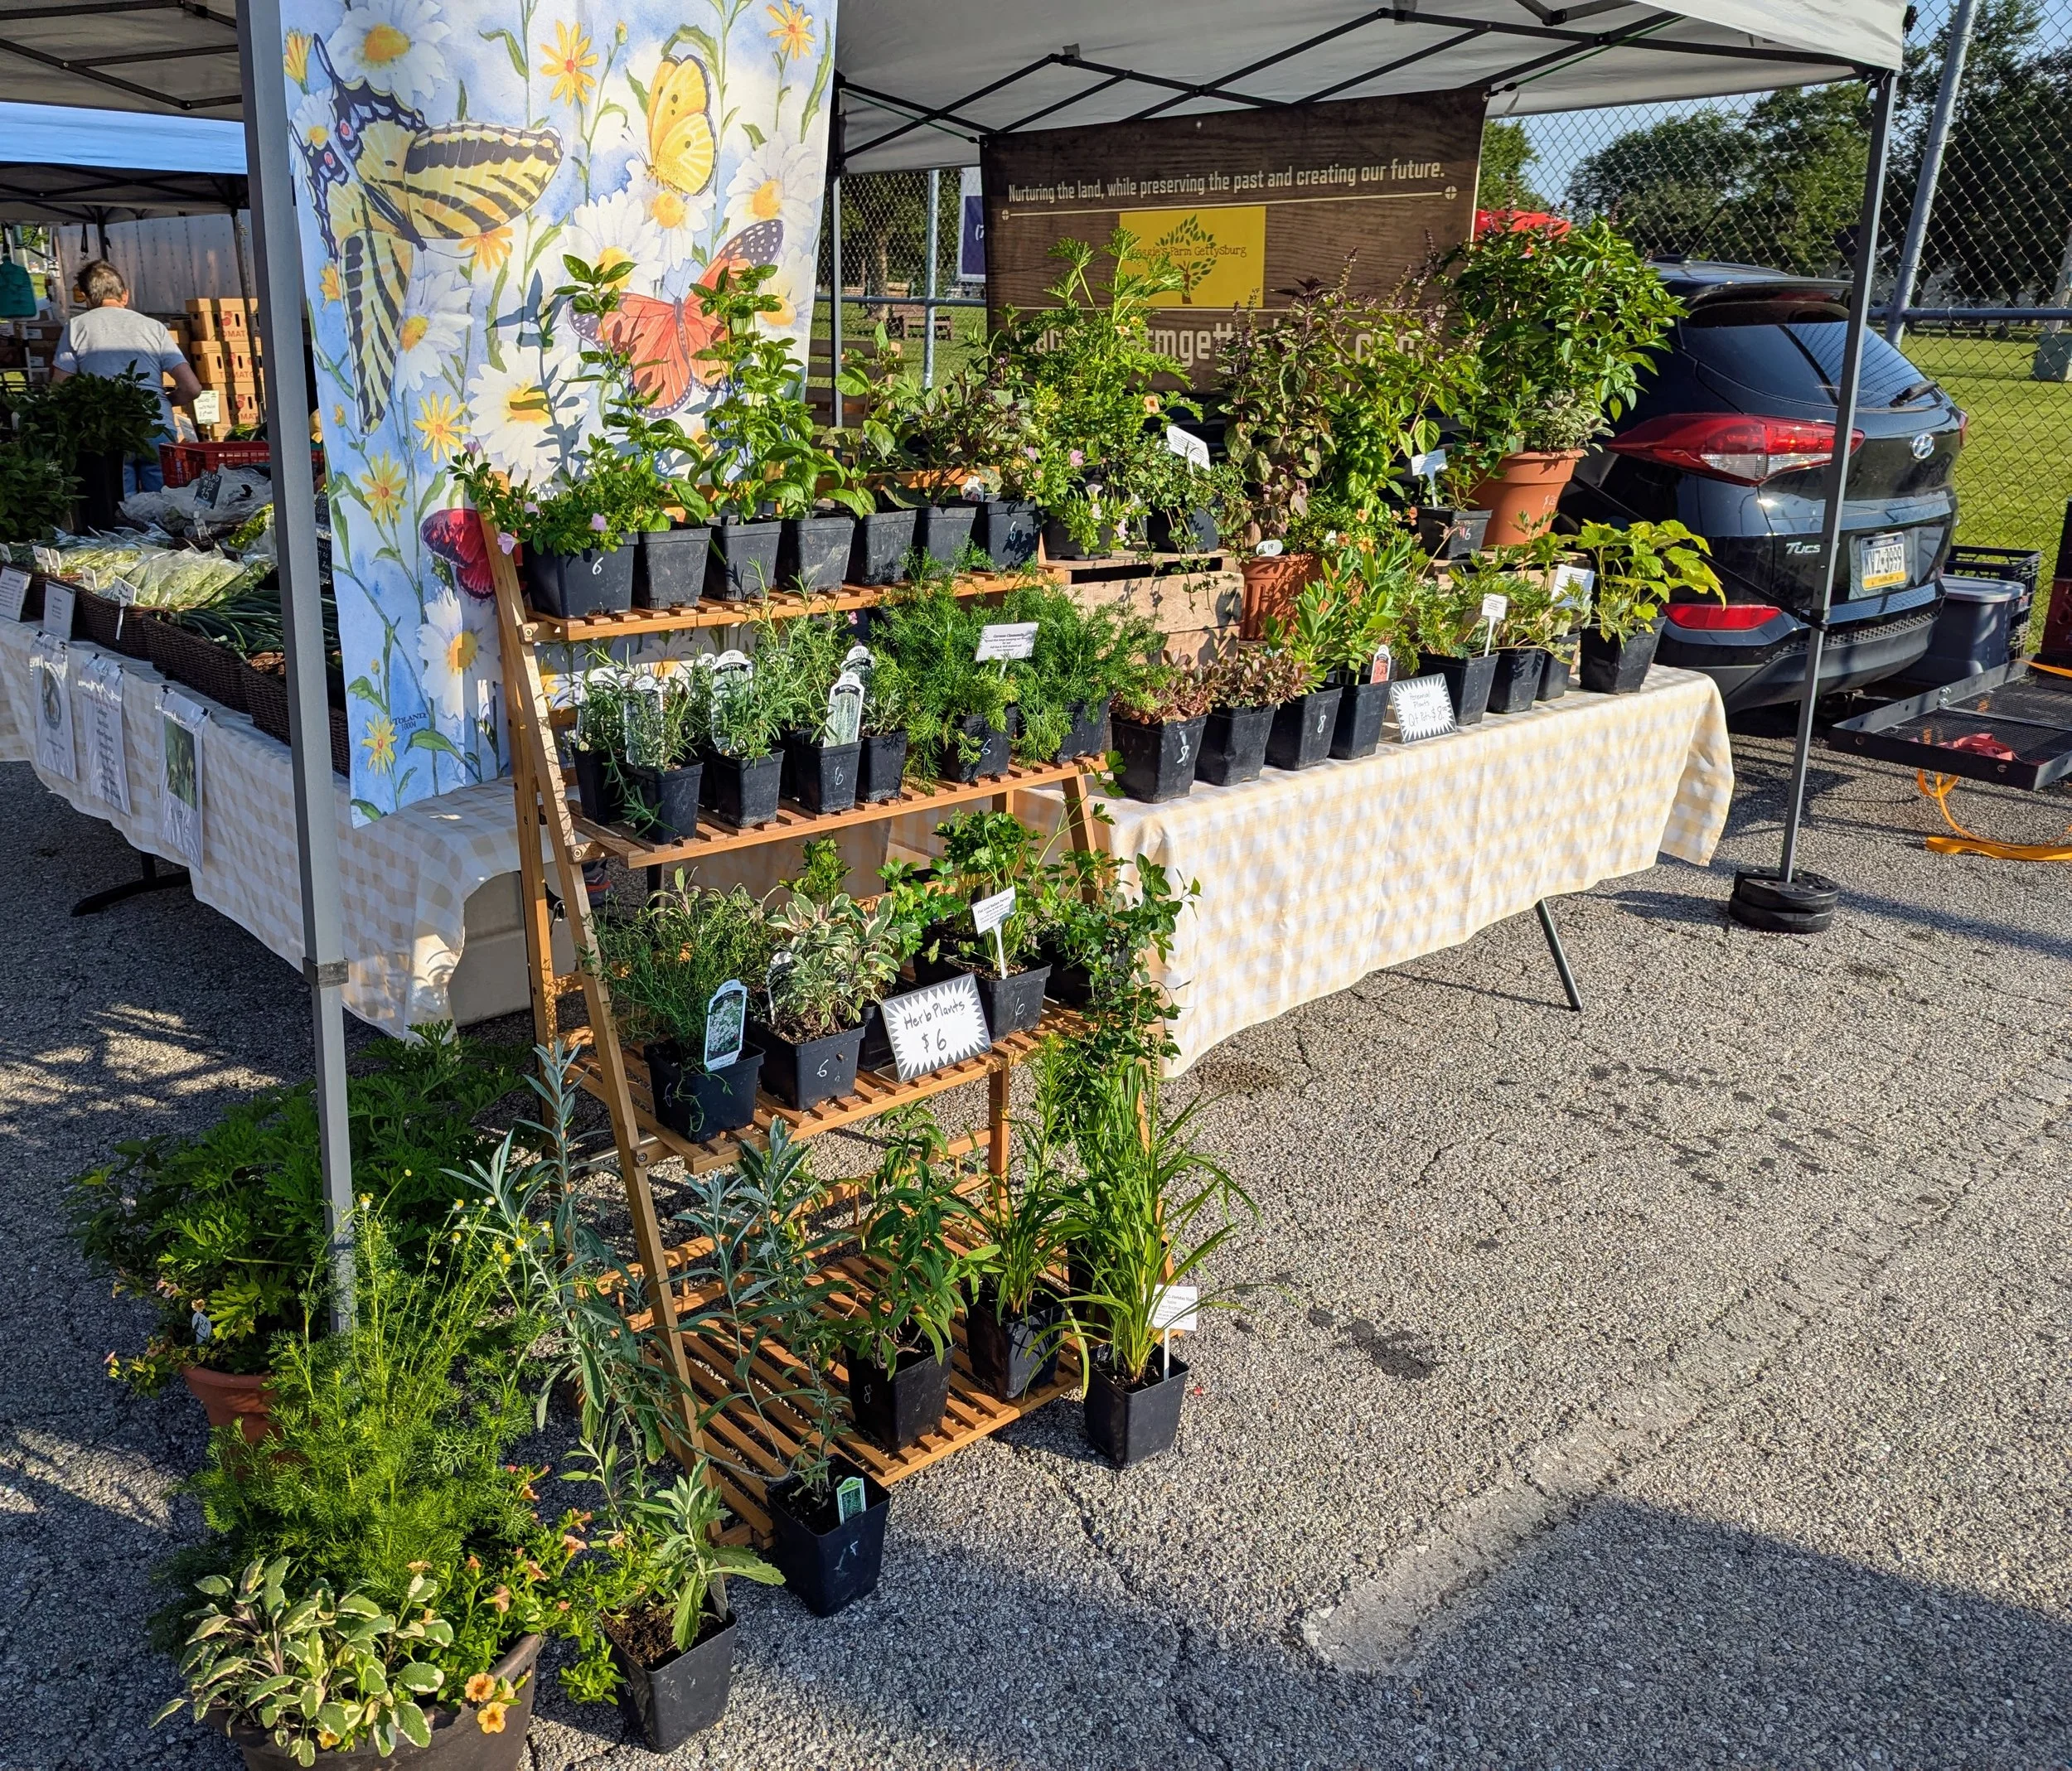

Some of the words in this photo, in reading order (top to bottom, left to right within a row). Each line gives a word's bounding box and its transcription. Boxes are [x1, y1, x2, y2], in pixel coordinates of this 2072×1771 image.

[1009, 184, 1054, 203] Nurturing
[1058, 181, 1075, 199] the
[1077, 179, 1105, 200] land,
[1107, 177, 1136, 197] while
[1140, 174, 1204, 198] preserving
[1208, 172, 1229, 191] the
[1234, 170, 1264, 193] past
[1268, 166, 1292, 187] and
[1296, 163, 1356, 187] creating
[1361, 166, 1386, 181] our
[1391, 158, 1445, 180] future.
[1786, 541, 1822, 554] TUCS
[592, 556, 604, 575] 6
[392, 713, 428, 726] TOLAND
[980, 738, 991, 755] 6
[903, 1009, 932, 1030] Herb
[932, 998, 966, 1019] Plants
[1014, 997, 1026, 1018] 6
[922, 1032, 929, 1053] $
[937, 1028, 946, 1051] 6
[816, 1059, 829, 1077] 6
[663, 1082, 672, 1107] 6
